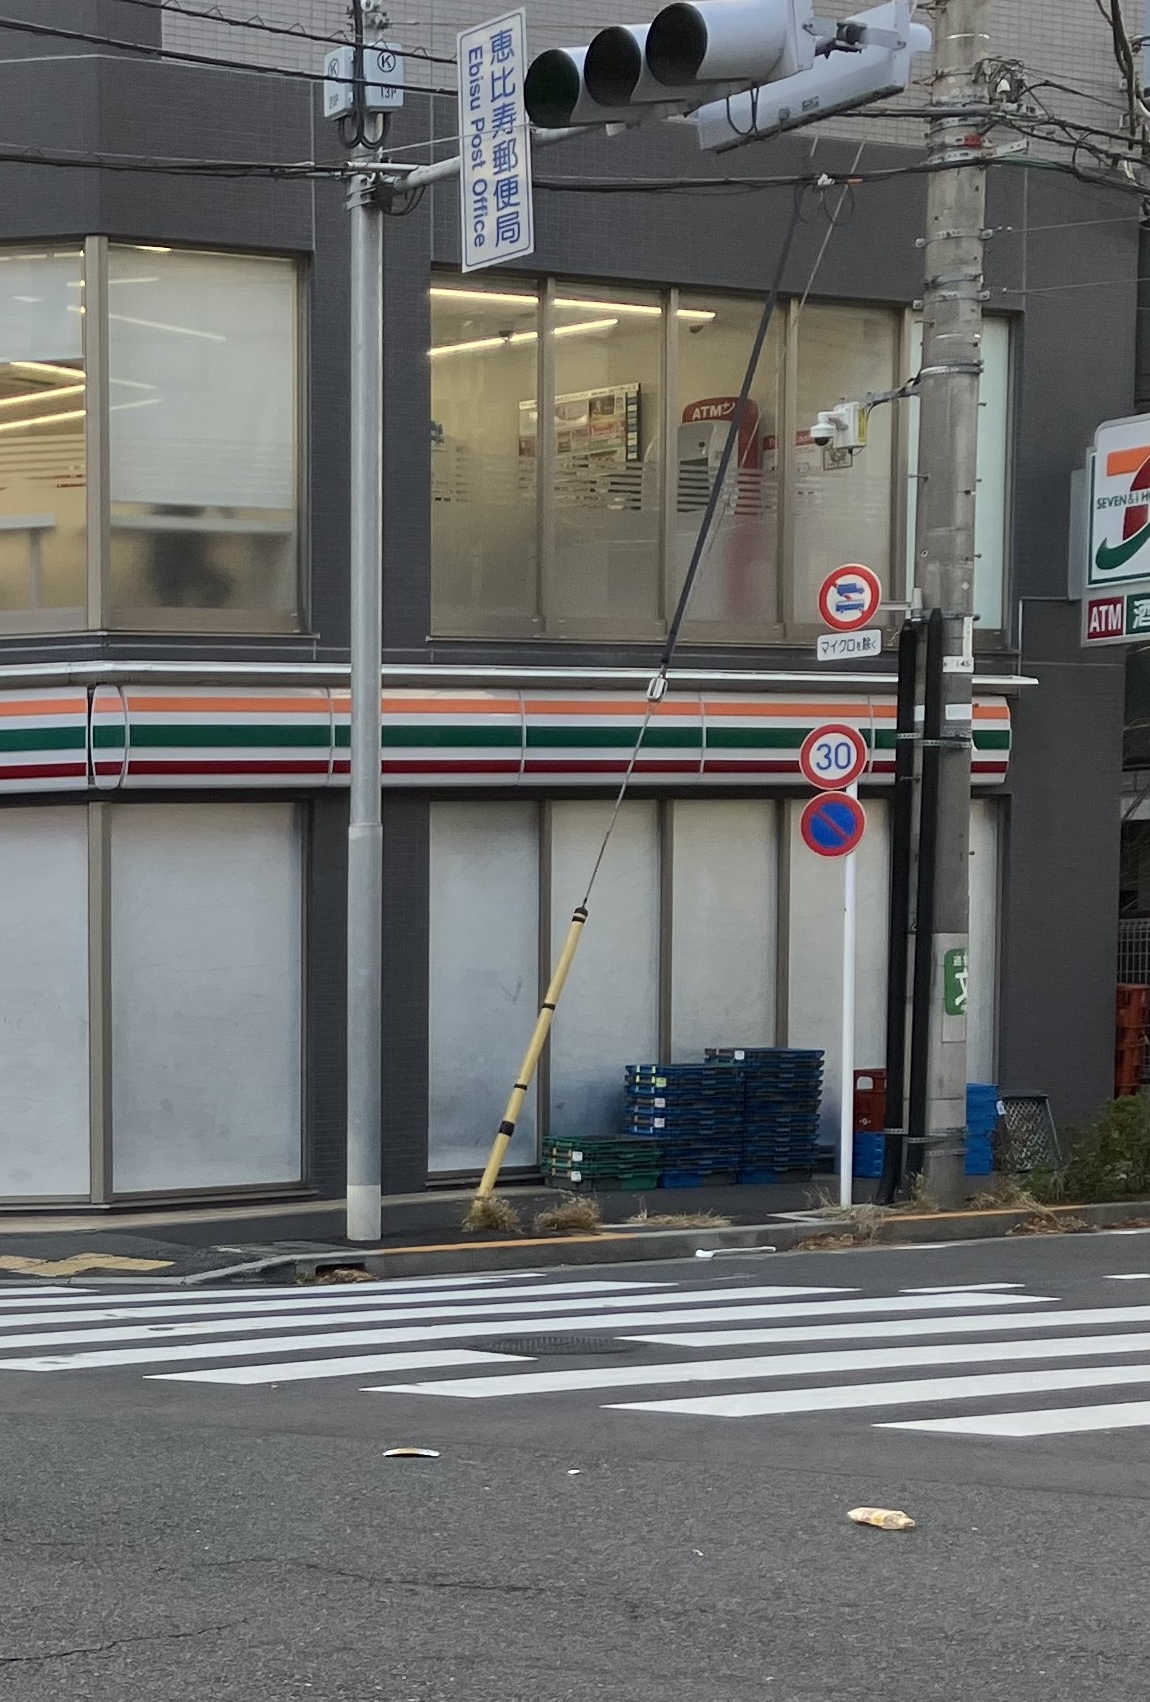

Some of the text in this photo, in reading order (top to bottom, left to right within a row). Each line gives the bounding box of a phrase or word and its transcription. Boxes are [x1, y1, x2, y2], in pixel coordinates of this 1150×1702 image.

[381, 54, 392, 69] K
[468, 45, 488, 248] Ebisu Post Office
[490, 27, 521, 248] 恵比寿郵便局
[692, 404, 722, 421] ATM
[1089, 603, 1122, 634] ATM
[820, 637, 877, 654] マイクロを除く
[816, 742, 851, 771] 30
